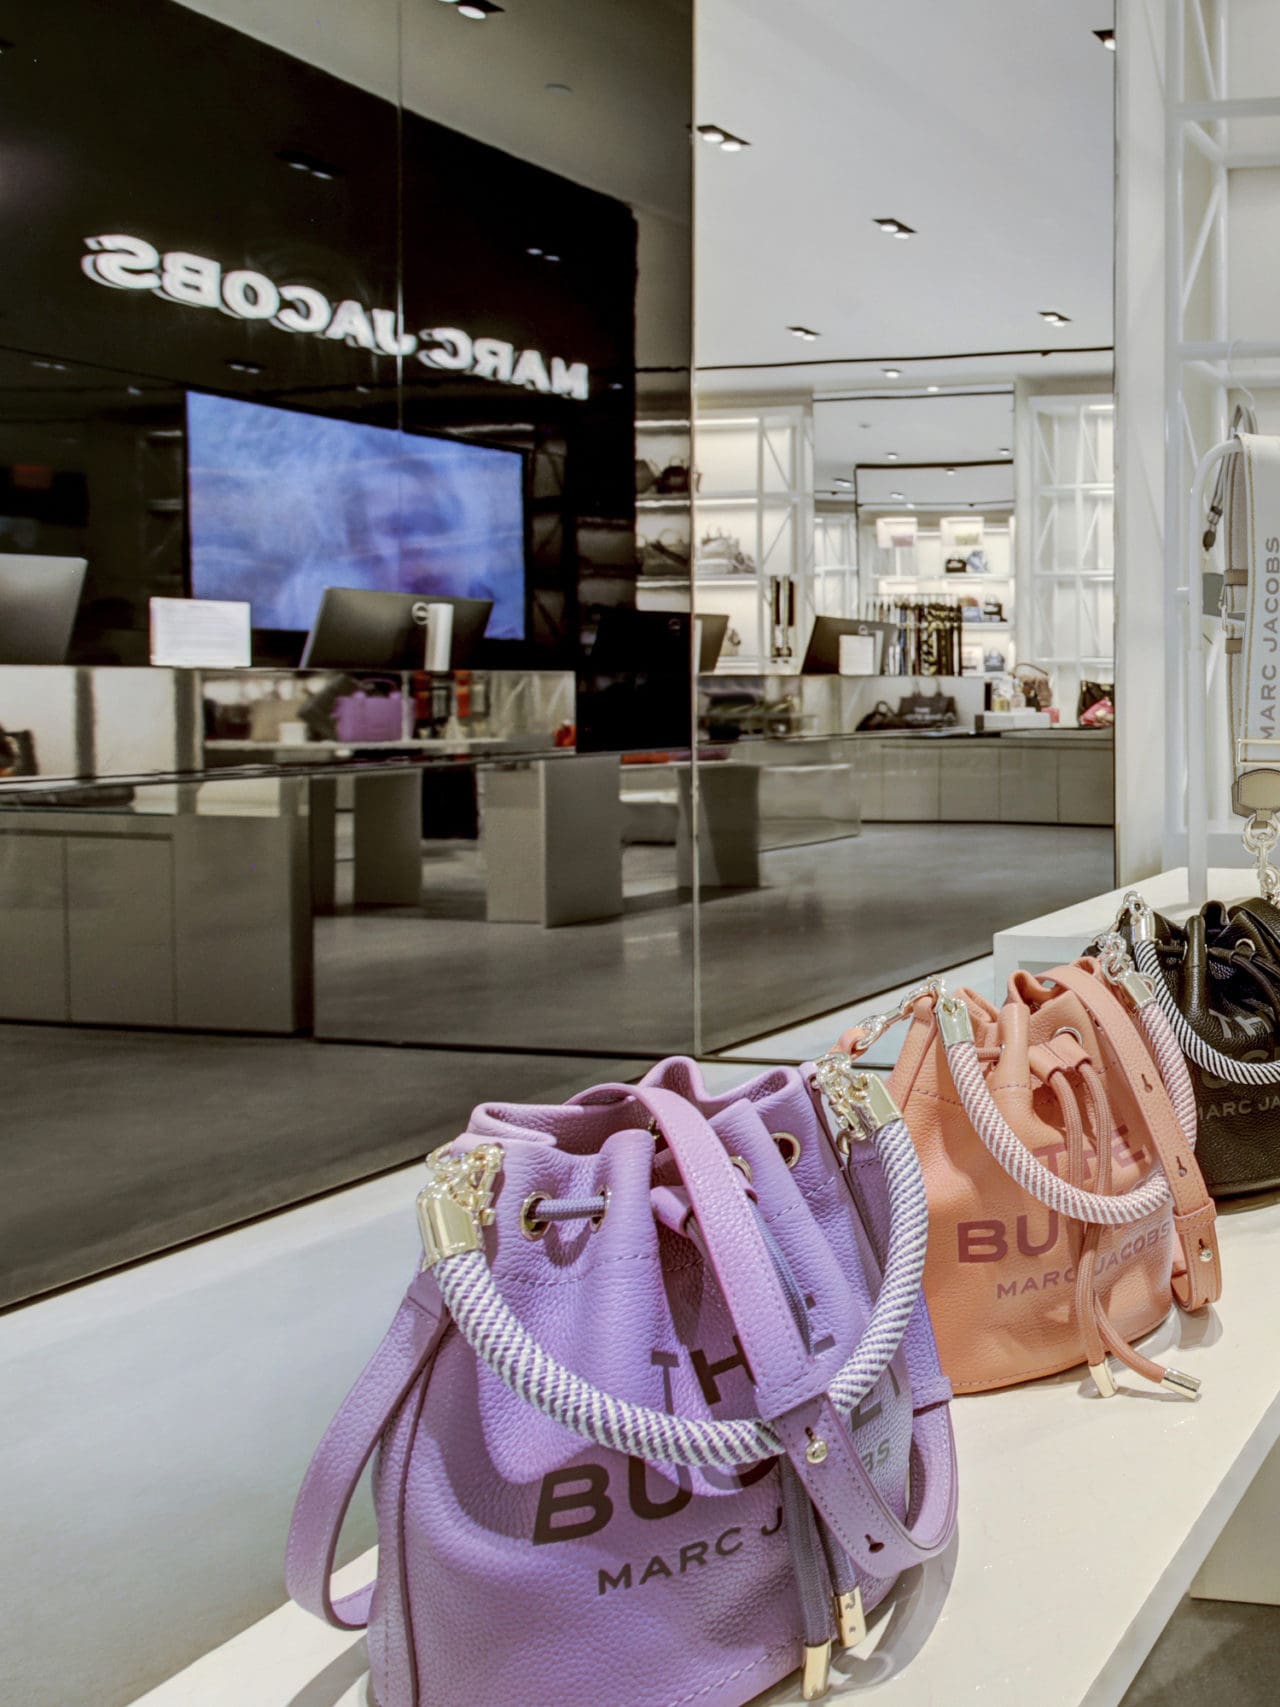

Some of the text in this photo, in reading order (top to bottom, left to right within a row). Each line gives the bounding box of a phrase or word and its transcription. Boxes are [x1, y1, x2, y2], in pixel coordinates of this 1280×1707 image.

[1259, 537, 1280, 740] MARC JACOBS
[598, 1526, 744, 1597] MARC
